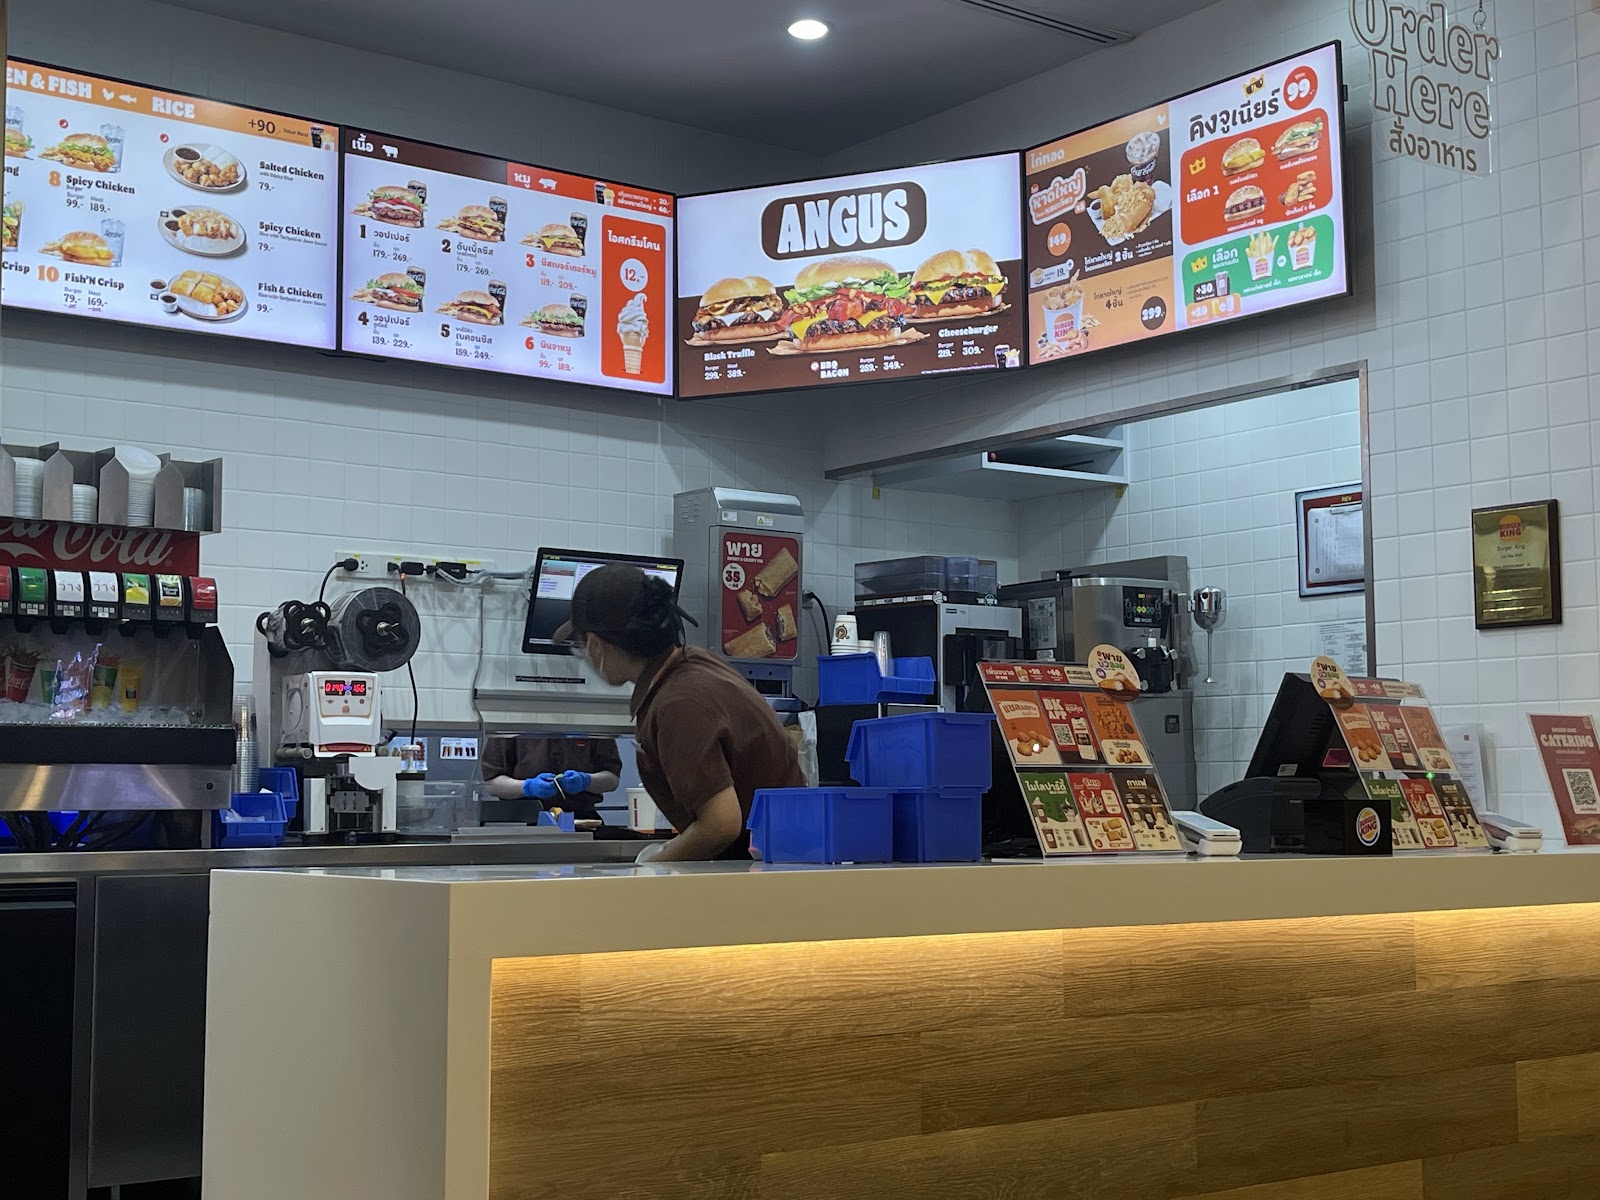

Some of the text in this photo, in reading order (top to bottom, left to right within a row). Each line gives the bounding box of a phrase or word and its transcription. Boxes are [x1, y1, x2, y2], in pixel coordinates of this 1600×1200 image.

[1352, 0, 1499, 80] Order
[30, 73, 45, 89] &
[48, 76, 92, 99] FISH
[1372, 49, 1489, 139] Here
[152, 96, 195, 119] RICE
[1189, 87, 1280, 142] คิงจูเนียร์
[352, 133, 374, 153] เนื้อ
[1389, 116, 1477, 172] สั่งอาหาร
[1030, 149, 1065, 169] ไก่ทอด
[260, 160, 324, 180] Salted Chicken
[49, 170, 135, 194] 8 Spicy Chicken
[259, 181, 275, 191] 79.-
[514, 172, 531, 189] หมู
[66, 184, 83, 192] Burger
[1186, 185, 1219, 203] เลือก 1
[66, 191, 85, 200] Burger
[66, 198, 111, 213] 99.- 189.-
[777, 188, 910, 254] ANGUS
[259, 221, 322, 239] Spicy Chicken
[360, 224, 410, 243] 1 วอปเปอร์
[258, 242, 274, 252] 79.-
[441, 238, 494, 256] 2 ดับเบิ้ลชีส
[607, 229, 661, 252] ไอศกรีมโคน
[373, 249, 412, 263] 179.- 269.-
[1122, 247, 1134, 260] ชิ้น
[1212, 247, 1238, 263] เลือก
[2, 261, 30, 275] Crisp
[456, 263, 494, 276] 179.- 269.-
[526, 253, 597, 278] 3 ชีสเบอร์เกอร์หมู
[37, 264, 59, 283] 10
[97, 278, 125, 291] Crisp
[624, 268, 645, 283] 12.-
[64, 286, 82, 294] Burger
[258, 282, 323, 299] Fish & Chicken
[540, 278, 577, 291] 119.- 209.-
[63, 293, 81, 304] 79.-
[87, 296, 108, 307] 169.-
[1106, 296, 1123, 309] 4 ชิ้น
[256, 304, 273, 313] 99.-
[1142, 305, 1165, 321] 299.-
[358, 311, 410, 326] 4 วอปเปอร์
[1054, 320, 1074, 330] BURGER
[440, 323, 493, 344] 5 เบคอนชีส
[938, 324, 999, 338] Cheeseburger
[372, 336, 413, 349] 139.- 229.-
[525, 336, 571, 355] 6 นินจาหมู
[455, 348, 494, 360] 159.- 249.-
[704, 348, 756, 361] Black Truffle
[962, 346, 985, 356] 309.-
[538, 359, 574, 372] 99.- 189.-
[820, 360, 839, 370] BBQ
[859, 361, 904, 373] 259.- 349.-
[704, 369, 746, 380] 299.- 389.-
[820, 368, 850, 379] BACON
[1500, 528, 1521, 538] KING
[726, 541, 762, 557] พาย
[58, 577, 82, 593] ว่าง
[93, 577, 116, 593] ว่าง
[1101, 651, 1123, 662] พาย
[1042, 698, 1064, 711] BK
[1048, 710, 1068, 720] APP
[1540, 734, 1594, 748] CATERING
[1025, 779, 1067, 792] ไมโลปาร์ตี้
[1126, 778, 1147, 788] กาแฟ
[1360, 814, 1376, 827] BURGER
[1360, 820, 1377, 835] KING
